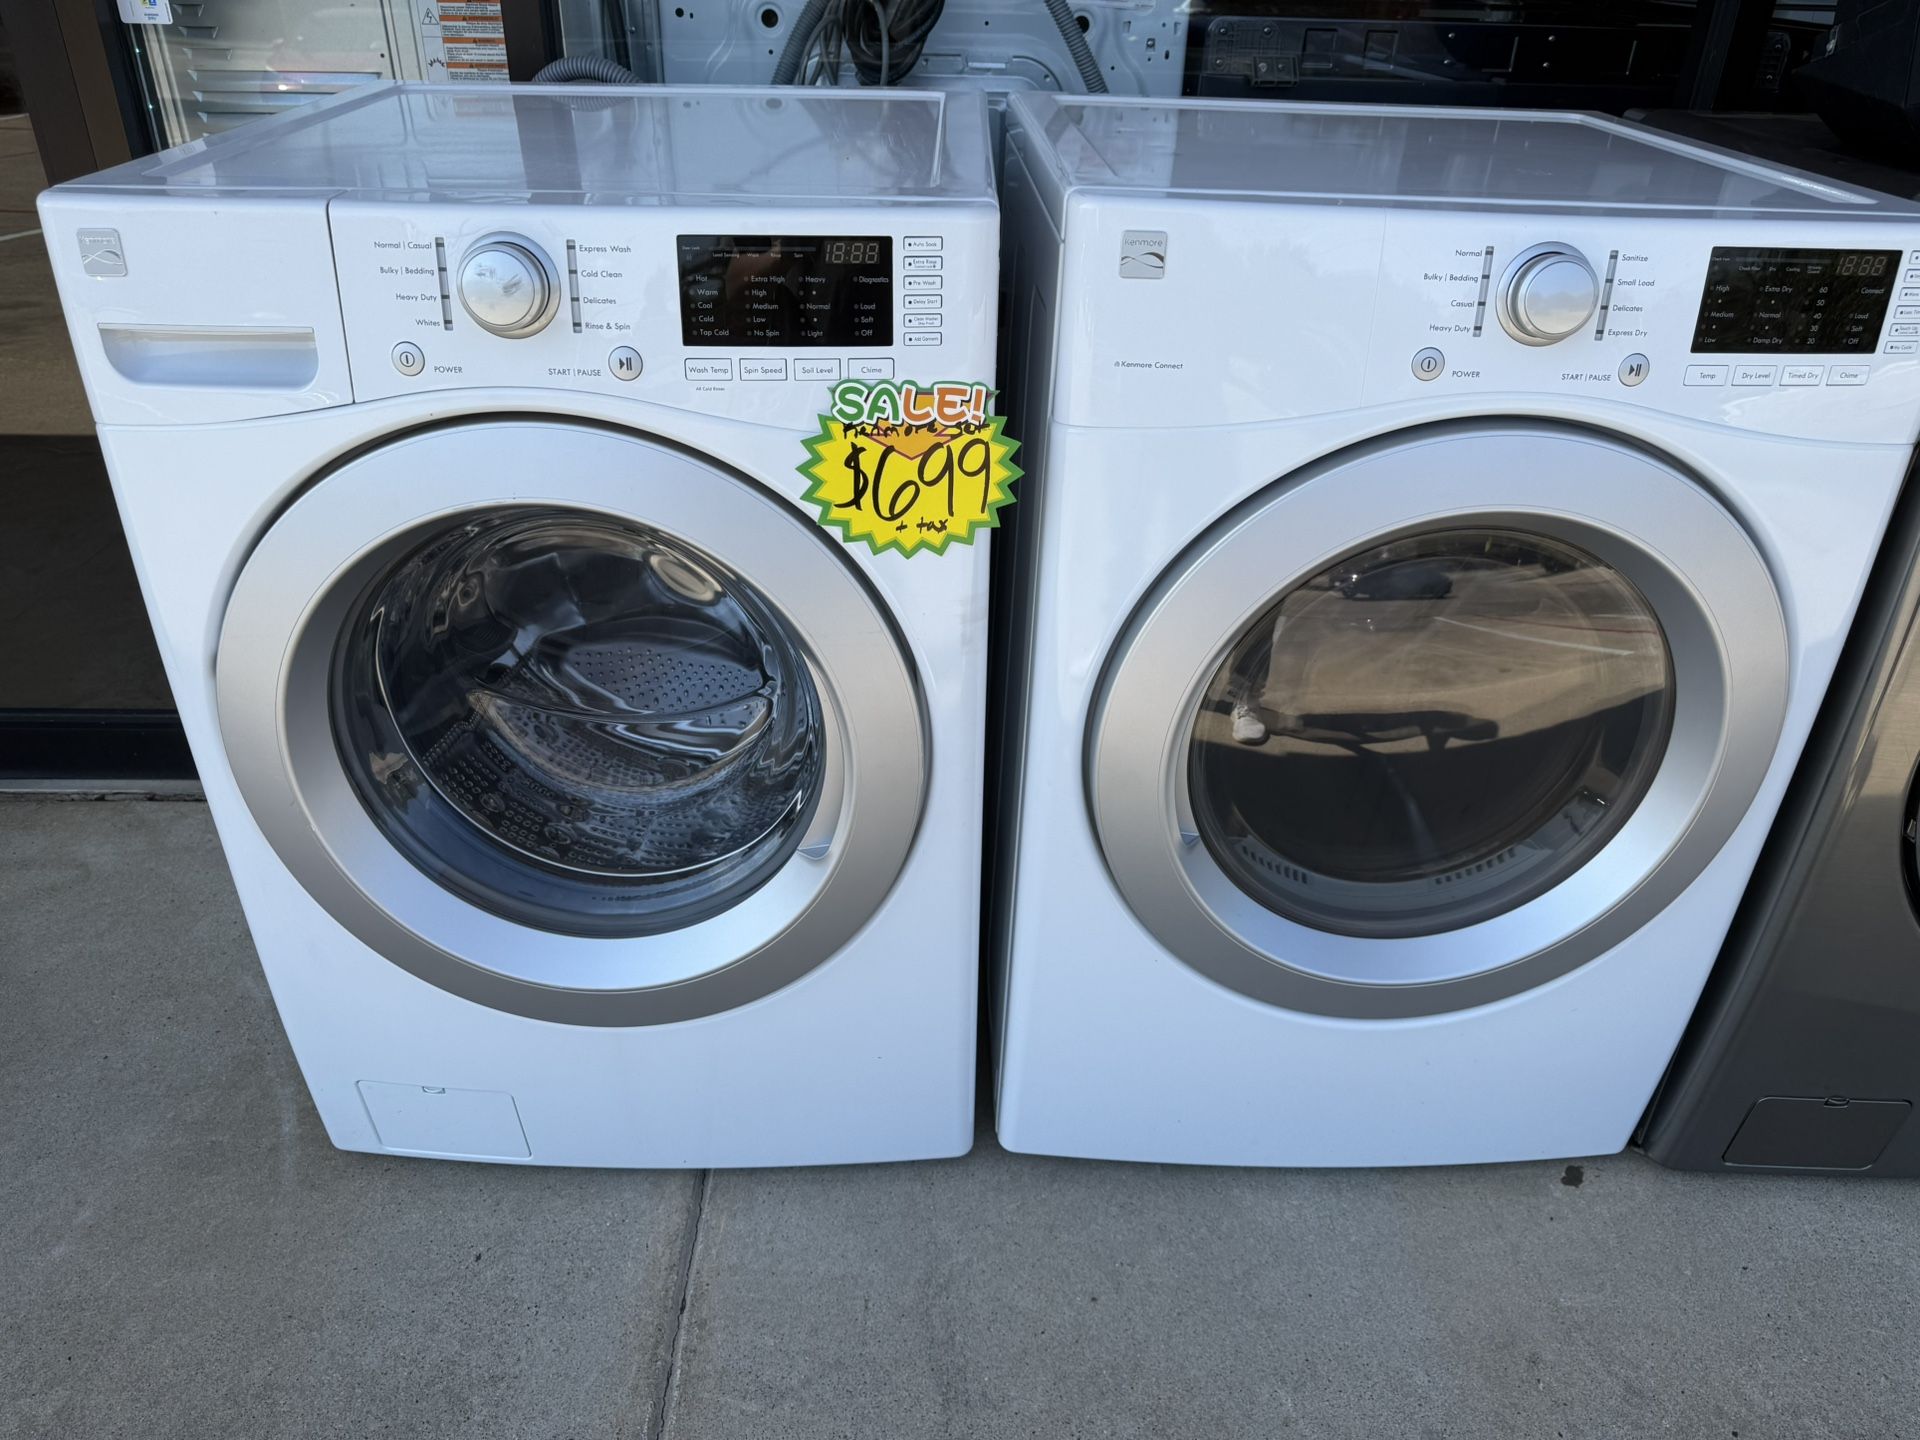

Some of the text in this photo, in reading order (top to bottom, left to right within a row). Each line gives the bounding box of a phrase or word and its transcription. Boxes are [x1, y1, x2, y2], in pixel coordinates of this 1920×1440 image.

[374, 241, 401, 249] Normal
[407, 241, 432, 250] Casual
[1124, 239, 1163, 248] Kenmore
[579, 244, 632, 254] Express Wash
[1455, 249, 1483, 257] Normal
[1622, 254, 1649, 262] Sanitize
[380, 266, 398, 275] Bulky
[405, 266, 434, 276] Bedding
[581, 270, 623, 278] Cold Clean
[751, 275, 786, 285] Extra High
[805, 275, 826, 284] Heavy
[1423, 273, 1443, 281] Bulky
[1449, 274, 1479, 283] Bedding
[697, 288, 718, 296] Warm
[752, 288, 767, 298] High
[1716, 284, 1731, 293] High
[1782, 285, 1793, 294] Dry
[395, 293, 437, 302] Heavy Duty
[583, 296, 617, 305] Delicates
[697, 301, 713, 309] Cool
[752, 302, 779, 311] Medium
[806, 302, 831, 310] Normal
[860, 302, 876, 310] Loud
[1451, 300, 1476, 308] Casual
[1612, 304, 1643, 312] Delicates
[698, 315, 714, 323] Cold
[753, 315, 767, 323] Low
[1711, 311, 1735, 319] Medium
[1854, 312, 1869, 320] Loud
[415, 319, 440, 327] Whites
[860, 316, 874, 324] Soft
[584, 322, 631, 332] Rinse & Spin
[1429, 324, 1471, 333] Heavy Duty
[700, 328, 730, 337] Tap Cold
[754, 329, 780, 338] No Spin
[807, 329, 823, 338] Light
[860, 329, 873, 337] Off
[1608, 329, 1633, 337] Express
[1752, 337, 1784, 345] Damp Dry
[1847, 337, 1860, 345] Off
[1154, 361, 1183, 369] Connect
[434, 366, 463, 374] POWER
[548, 368, 571, 376] START
[577, 369, 601, 377] PAUSE
[688, 366, 729, 376] Wash Temp
[744, 366, 783, 376] Spin Speed
[802, 366, 834, 375] Soil Level
[860, 366, 883, 374] Chime
[1451, 370, 1481, 378] POWER
[1561, 373, 1584, 381] START
[1588, 374, 1611, 382] PAUSE
[1699, 372, 1716, 380] Temp
[1741, 372, 1753, 381] Dry
[1807, 372, 1819, 380] Dry
[834, 384, 987, 425] SALE!
[833, 439, 991, 522] $699
[916, 516, 948, 534] tax
